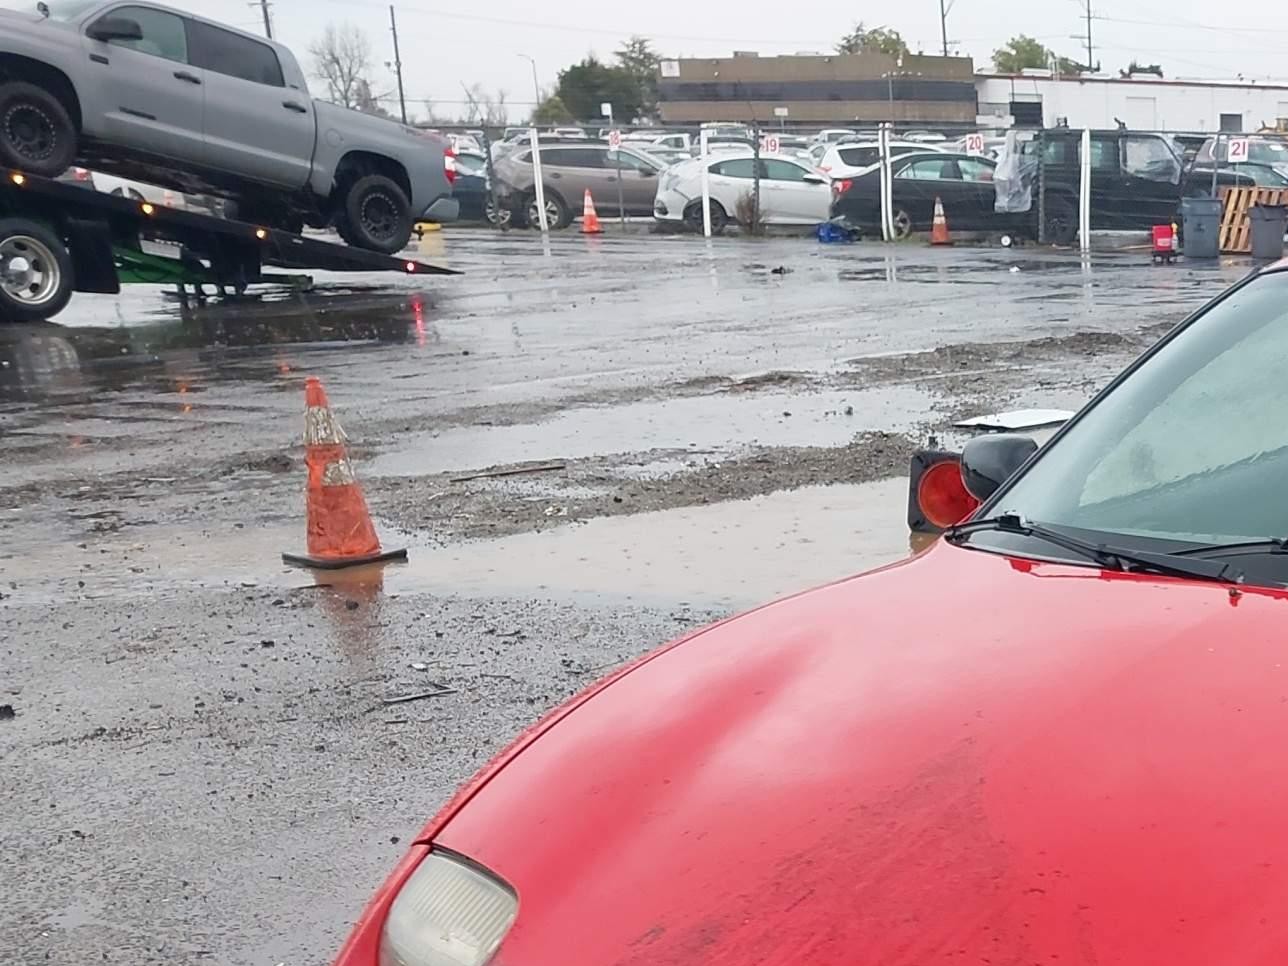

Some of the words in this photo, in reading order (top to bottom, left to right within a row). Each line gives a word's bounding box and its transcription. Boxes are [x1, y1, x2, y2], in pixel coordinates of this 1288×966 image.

[766, 138, 778, 152] 19
[968, 136, 981, 151] 20
[1231, 141, 1246, 156] 21
